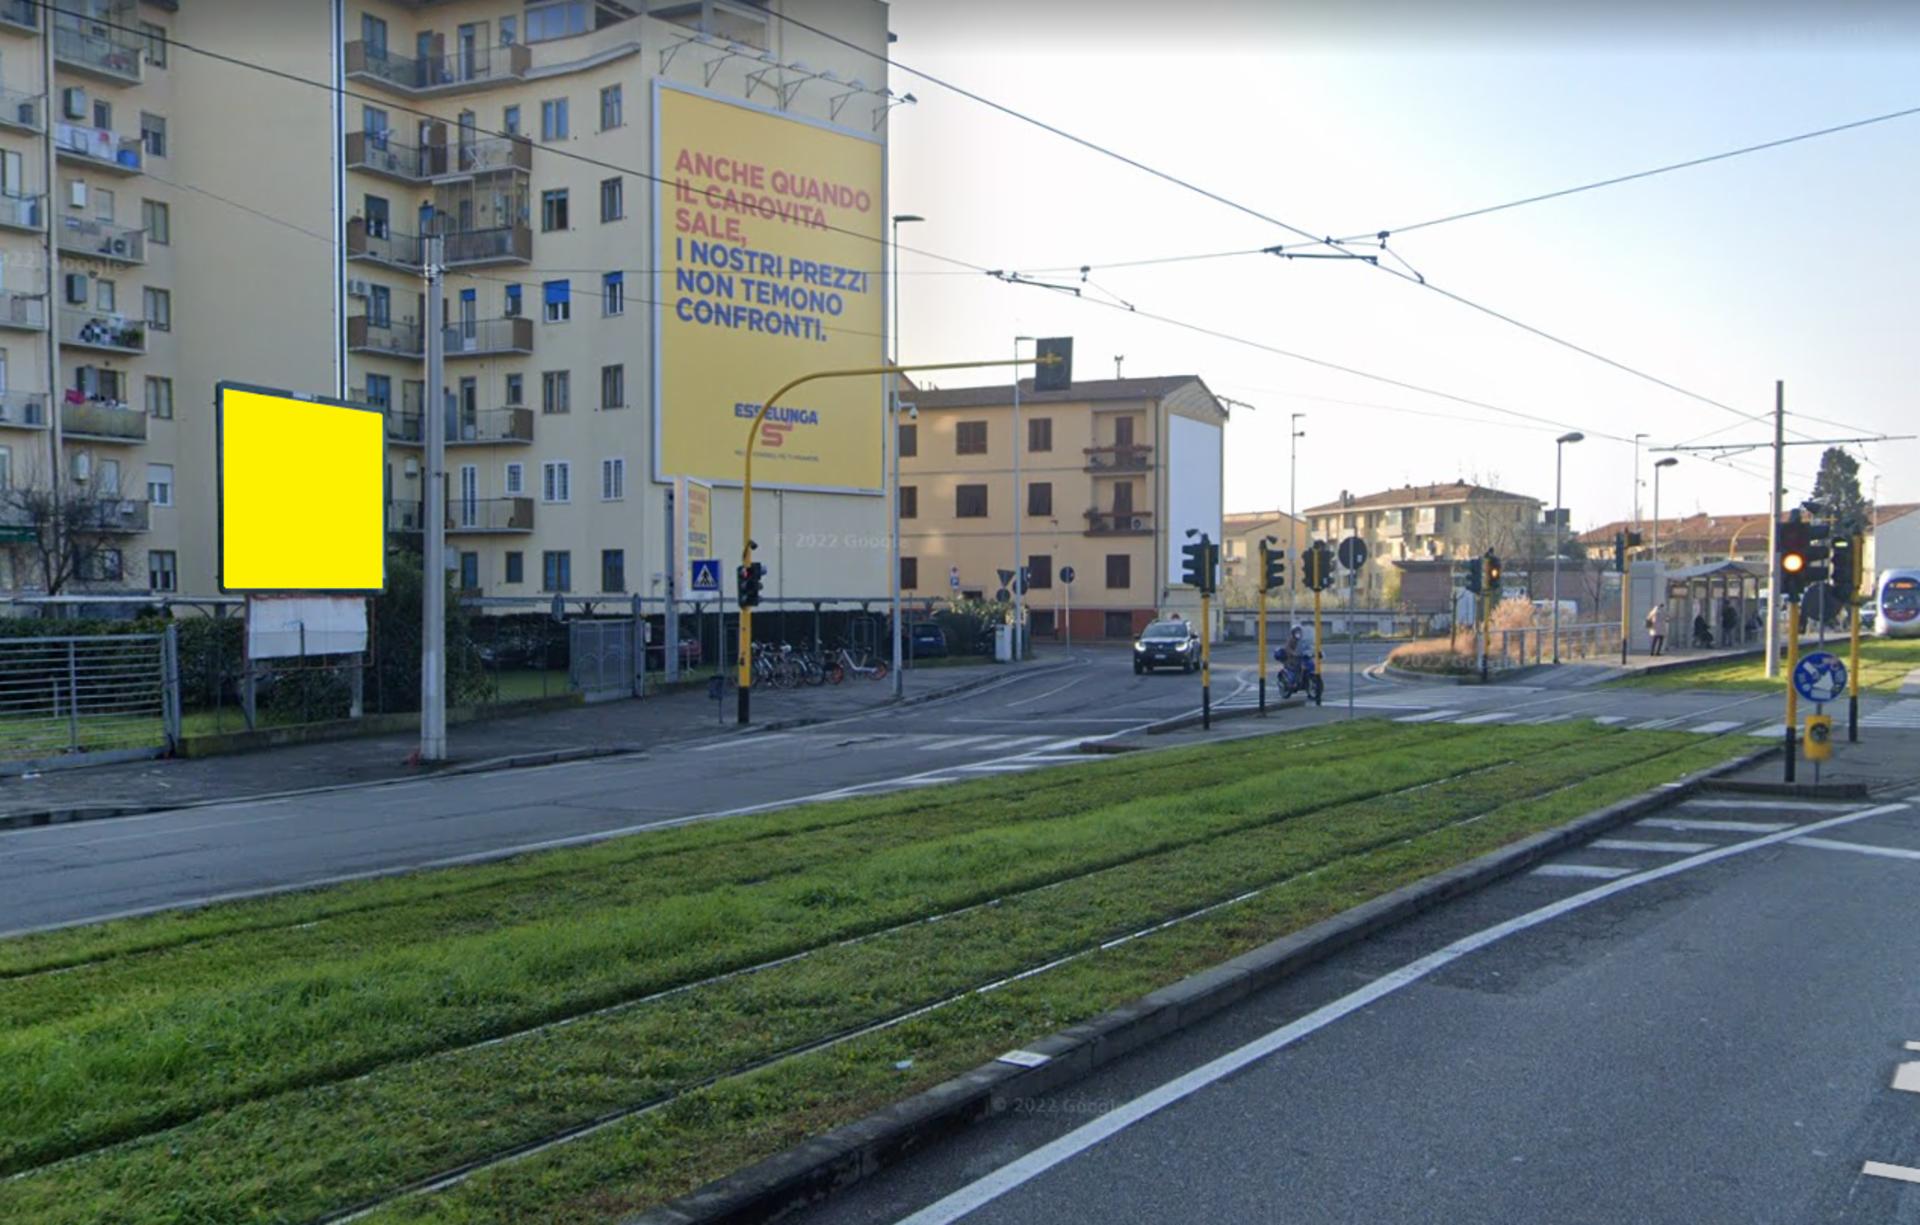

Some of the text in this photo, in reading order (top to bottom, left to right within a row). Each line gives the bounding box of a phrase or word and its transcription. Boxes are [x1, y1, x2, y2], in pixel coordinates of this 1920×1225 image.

[675, 148, 872, 214] ANCHE QUANDO
[675, 177, 828, 232] IL CAROVITA
[675, 207, 748, 247] SALE,
[676, 237, 868, 294] I NOSTRI PREZZI
[676, 266, 844, 317] NON TEMONO
[675, 296, 828, 343] CONFRONTI.
